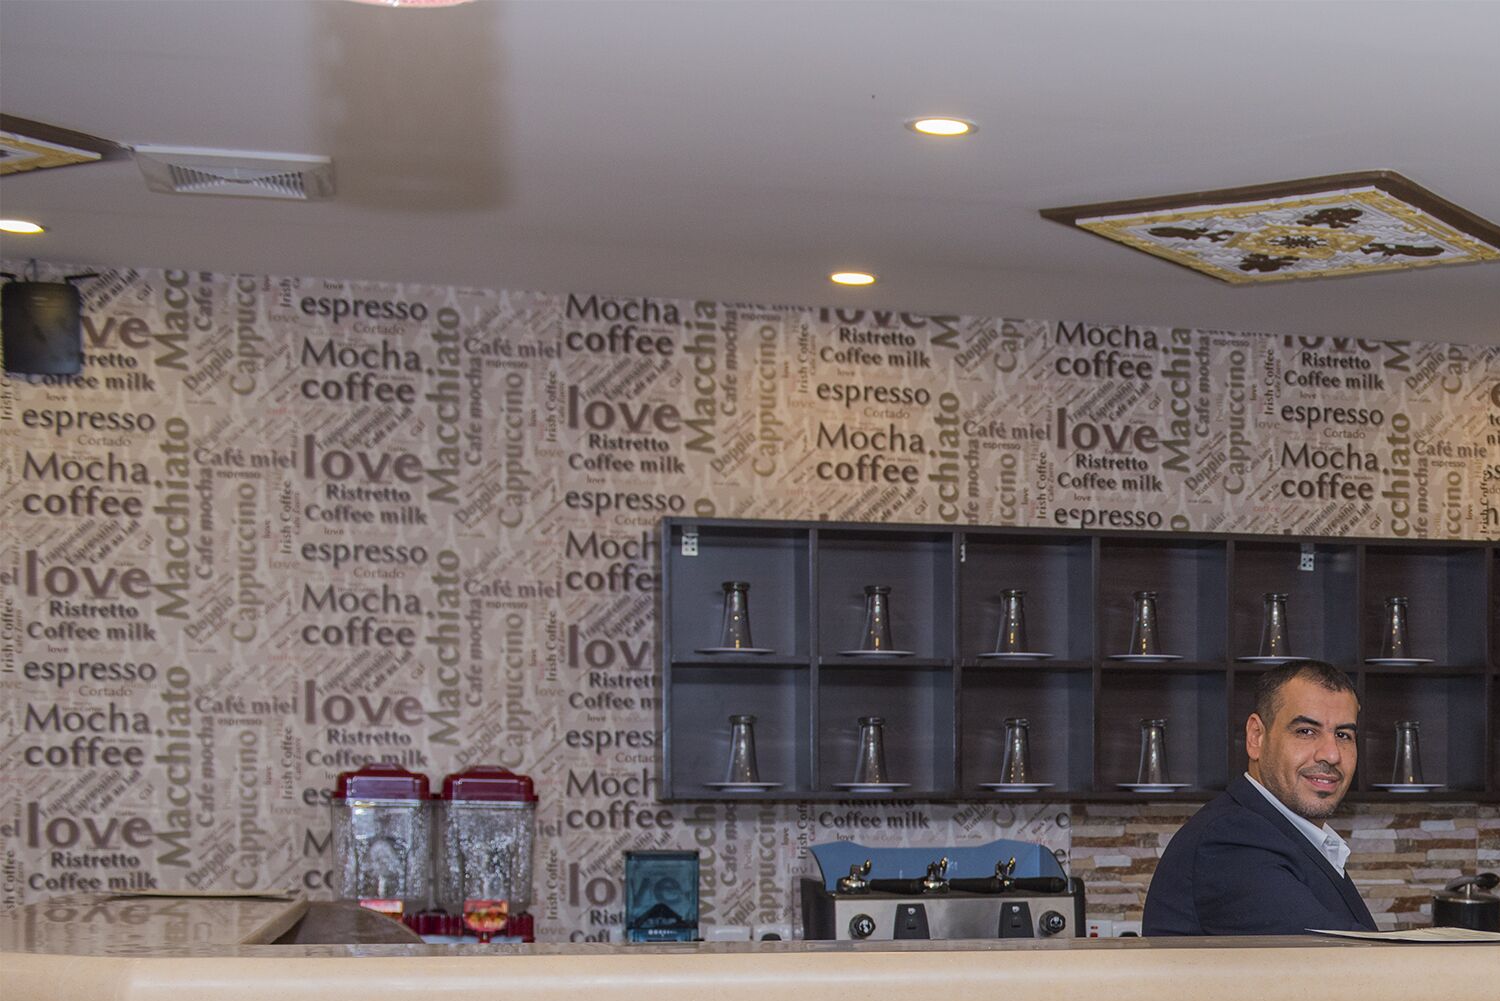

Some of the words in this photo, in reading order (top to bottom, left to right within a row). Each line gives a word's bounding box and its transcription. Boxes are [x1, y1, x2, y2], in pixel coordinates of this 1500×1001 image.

[301, 295, 429, 323] espresso
[566, 325, 675, 356] coffee
[838, 327, 917, 348] Ristretto
[955, 325, 998, 369] Doppio
[1055, 320, 1159, 351] Mocha
[302, 336, 422, 372] Mocha
[820, 346, 885, 370] Coffee
[888, 347, 931, 370] milk
[567, 384, 683, 433] love
[817, 381, 931, 409] espresso
[22, 408, 156, 437] espresso
[1281, 401, 1384, 428] espresso
[818, 422, 926, 456] Mocha
[1055, 406, 1159, 455] love
[193, 446, 247, 471] Café
[249, 449, 299, 470] miel
[498, 372, 525, 529] Cappuccino
[23, 450, 150, 486] Mocha
[23, 486, 143, 519] coffee
[155, 416, 191, 620] Macchiato
[25, 549, 155, 600] love
[48, 600, 139, 620] Ristretto
[26, 621, 102, 643] Coffee
[106, 621, 157, 643] milk
